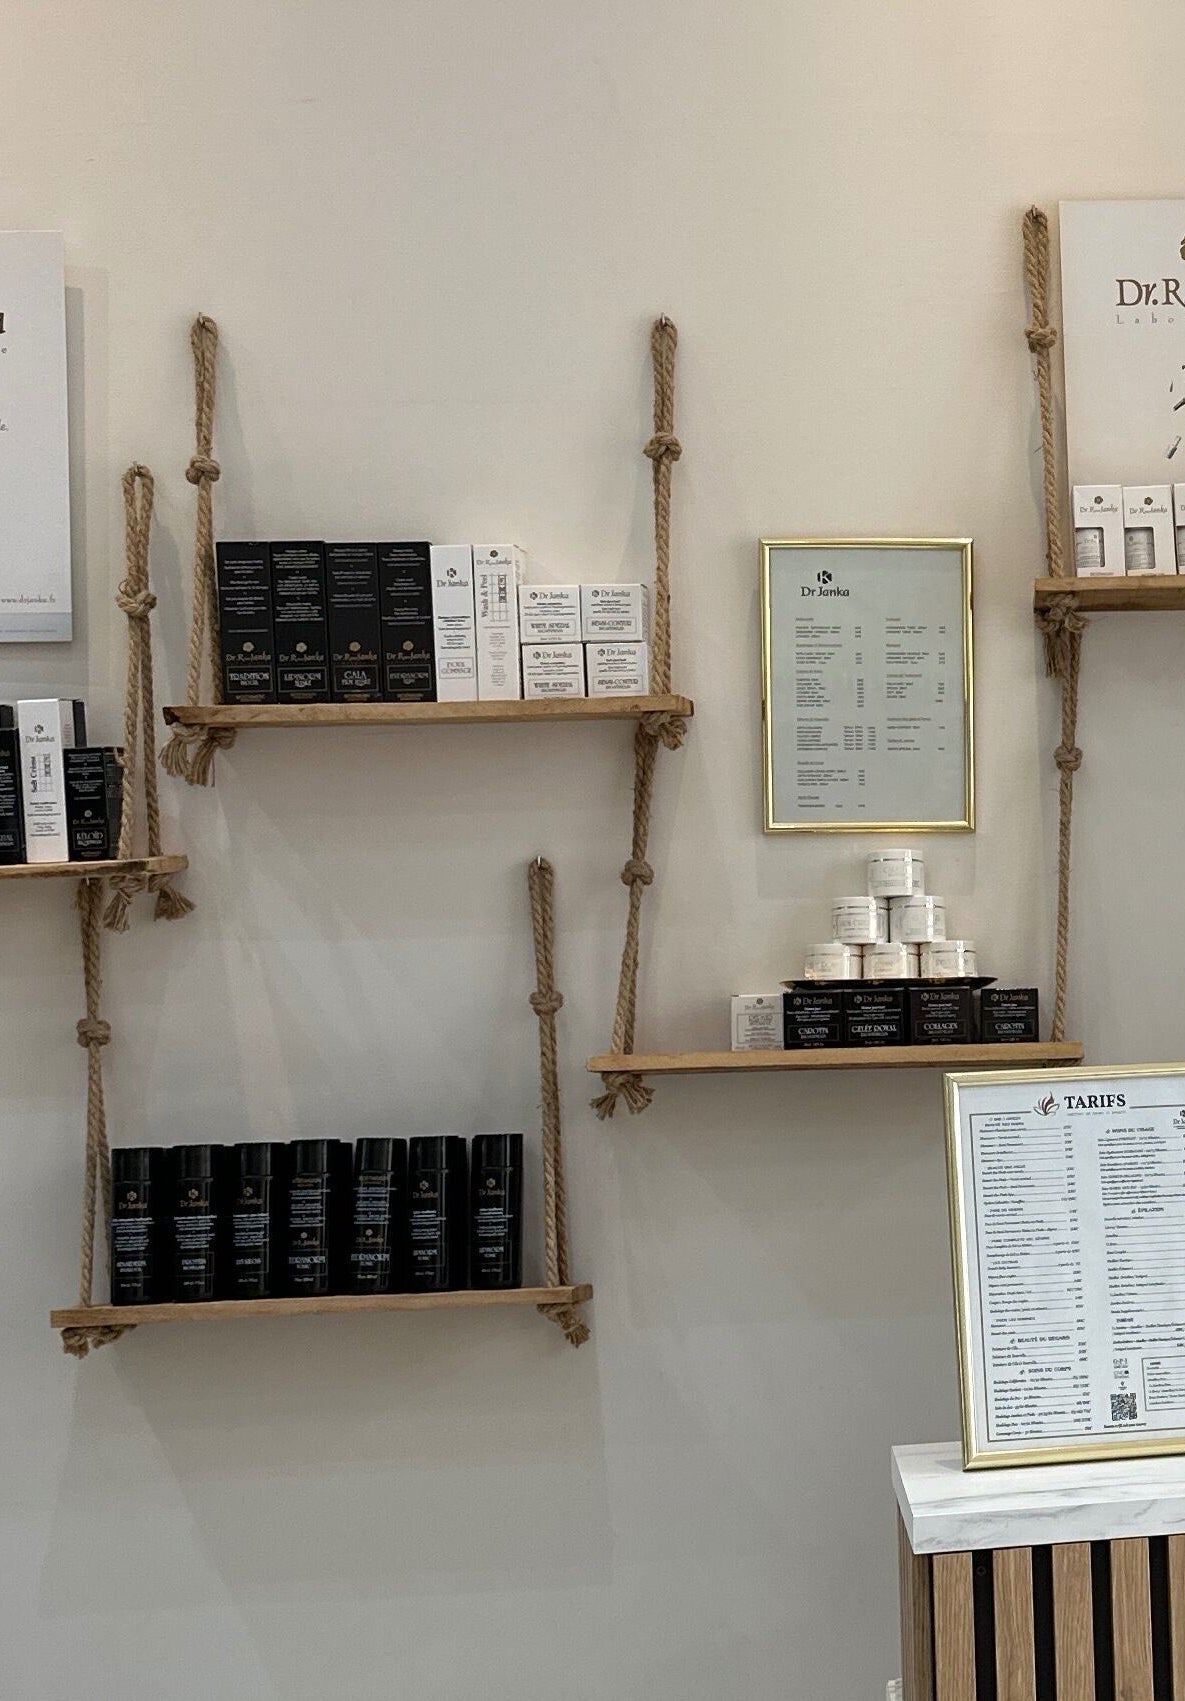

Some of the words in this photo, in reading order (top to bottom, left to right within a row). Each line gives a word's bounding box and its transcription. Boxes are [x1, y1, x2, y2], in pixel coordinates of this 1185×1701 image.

[801, 586, 816, 597] Dr
[816, 586, 850, 597] Janka
[1064, 1094, 1126, 1109] TARIFS
